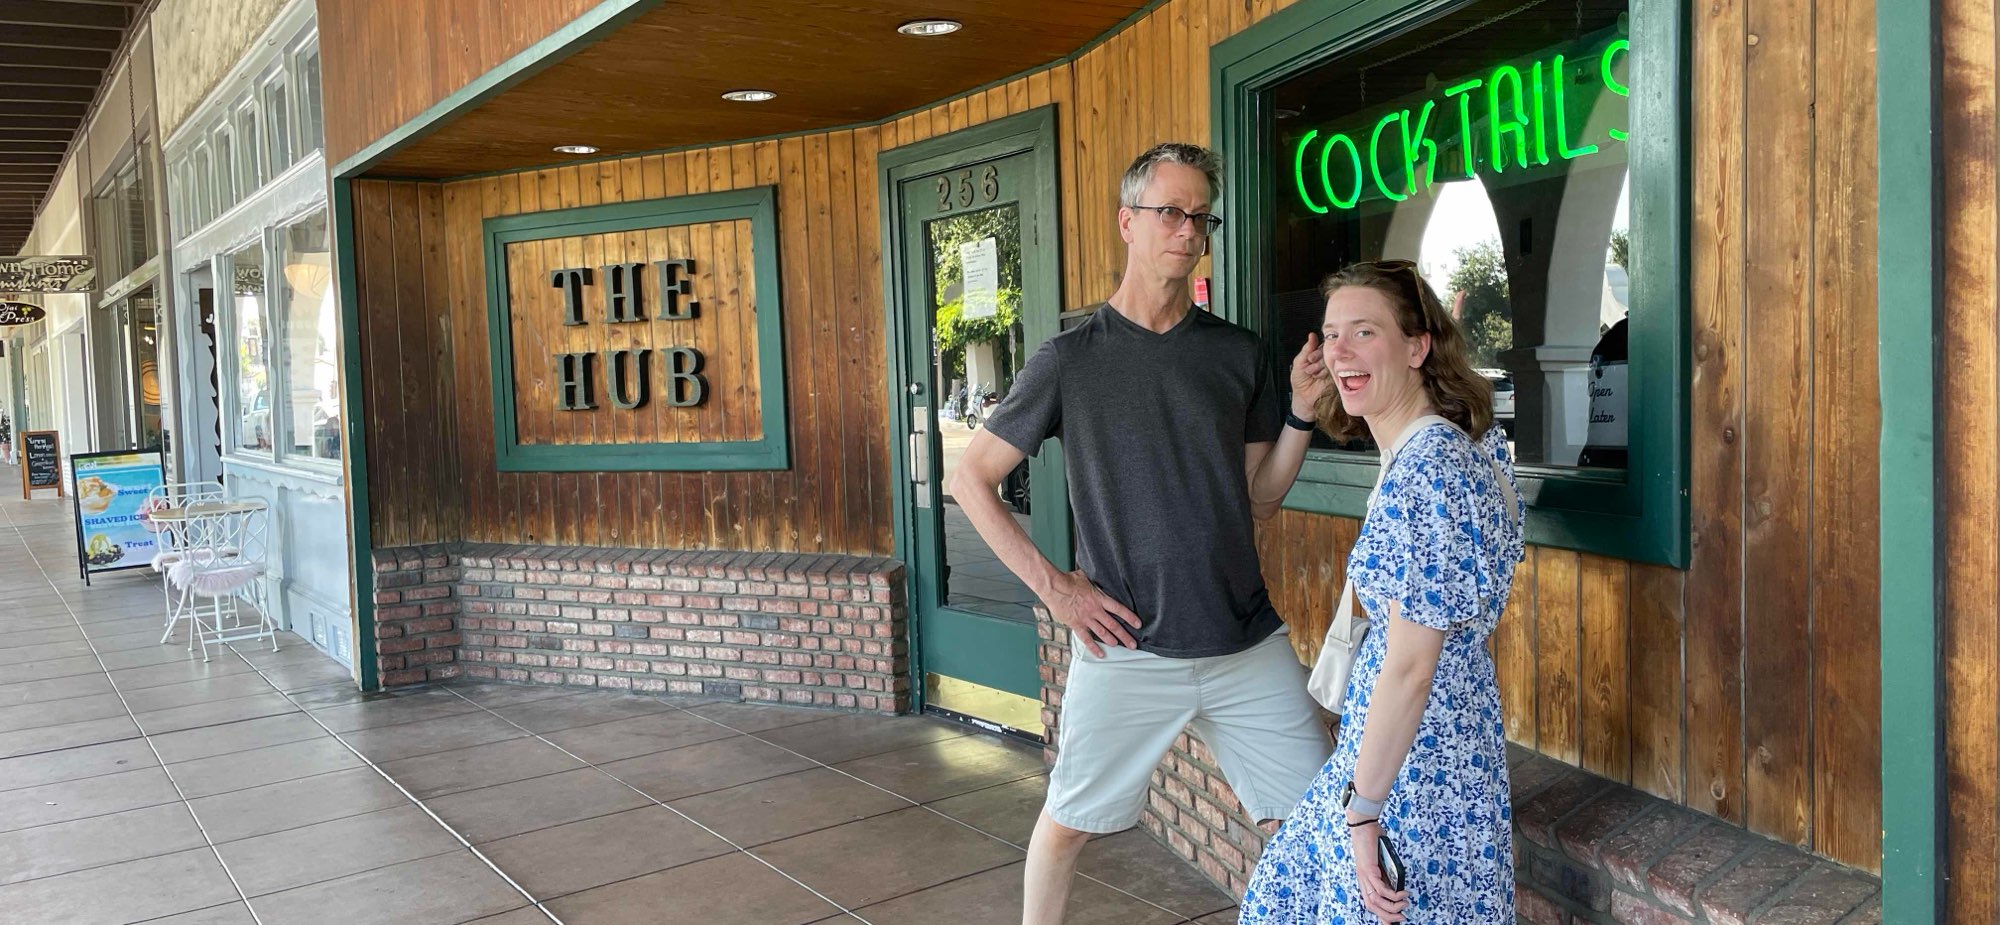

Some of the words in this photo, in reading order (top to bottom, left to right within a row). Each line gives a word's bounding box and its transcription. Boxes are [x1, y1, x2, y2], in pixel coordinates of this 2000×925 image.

[936, 165, 999, 212] 256
[32, 262, 85, 276] Home
[551, 258, 701, 326] THE
[0, 311, 35, 323] Press
[554, 347, 709, 411] HUB
[1588, 381, 1613, 402] Open
[1589, 407, 1616, 423] Later
[117, 488, 148, 496] Sweet
[85, 515, 127, 525] SHAVED
[125, 540, 153, 548] Treat
